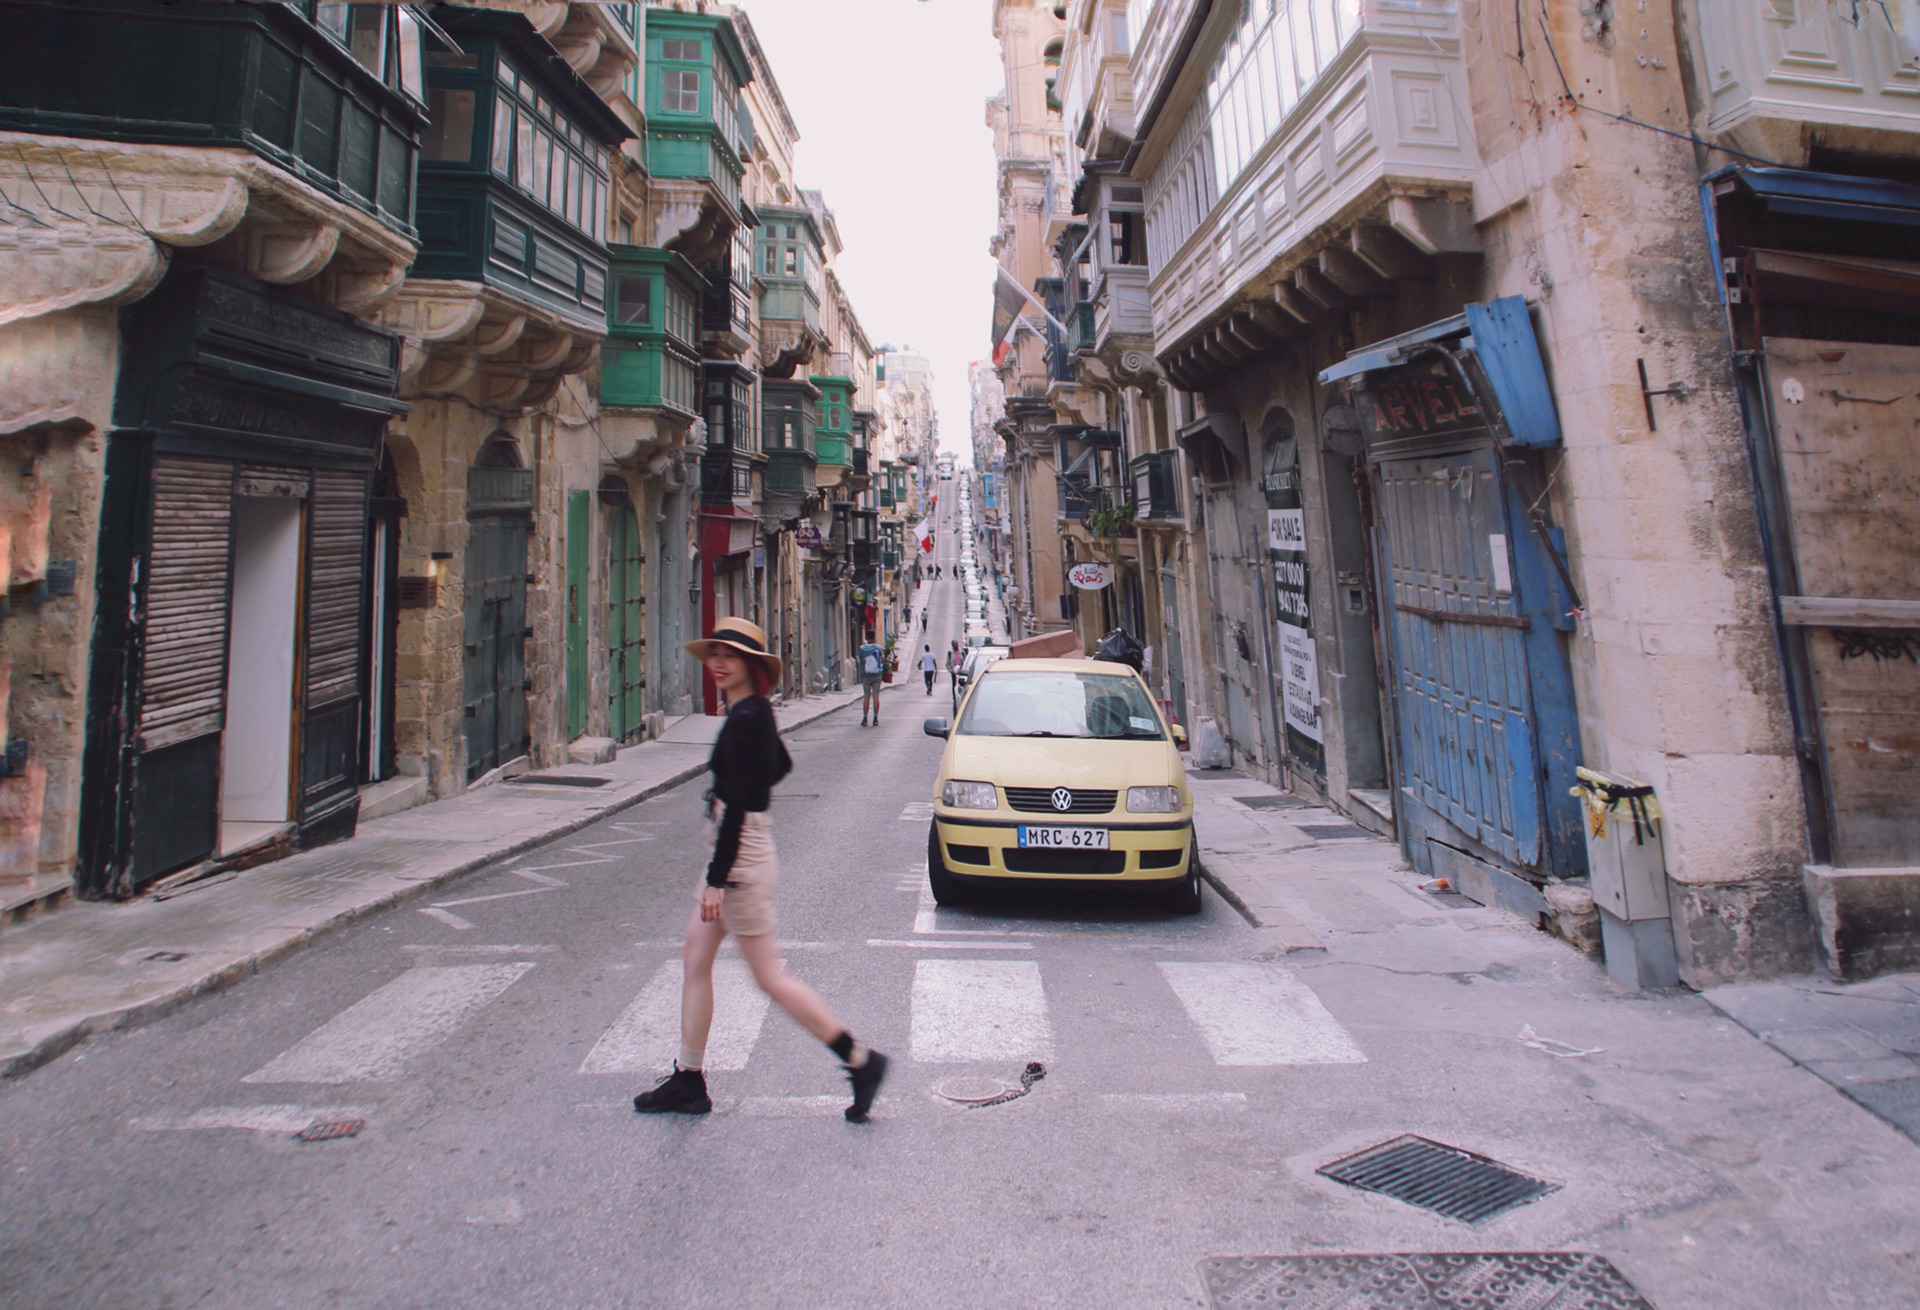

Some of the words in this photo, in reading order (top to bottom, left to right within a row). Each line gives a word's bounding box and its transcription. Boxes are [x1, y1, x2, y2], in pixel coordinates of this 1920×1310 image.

[1282, 517, 1302, 542] SALE
[1028, 829, 1063, 846] MRC
[1071, 830, 1105, 847] 627
